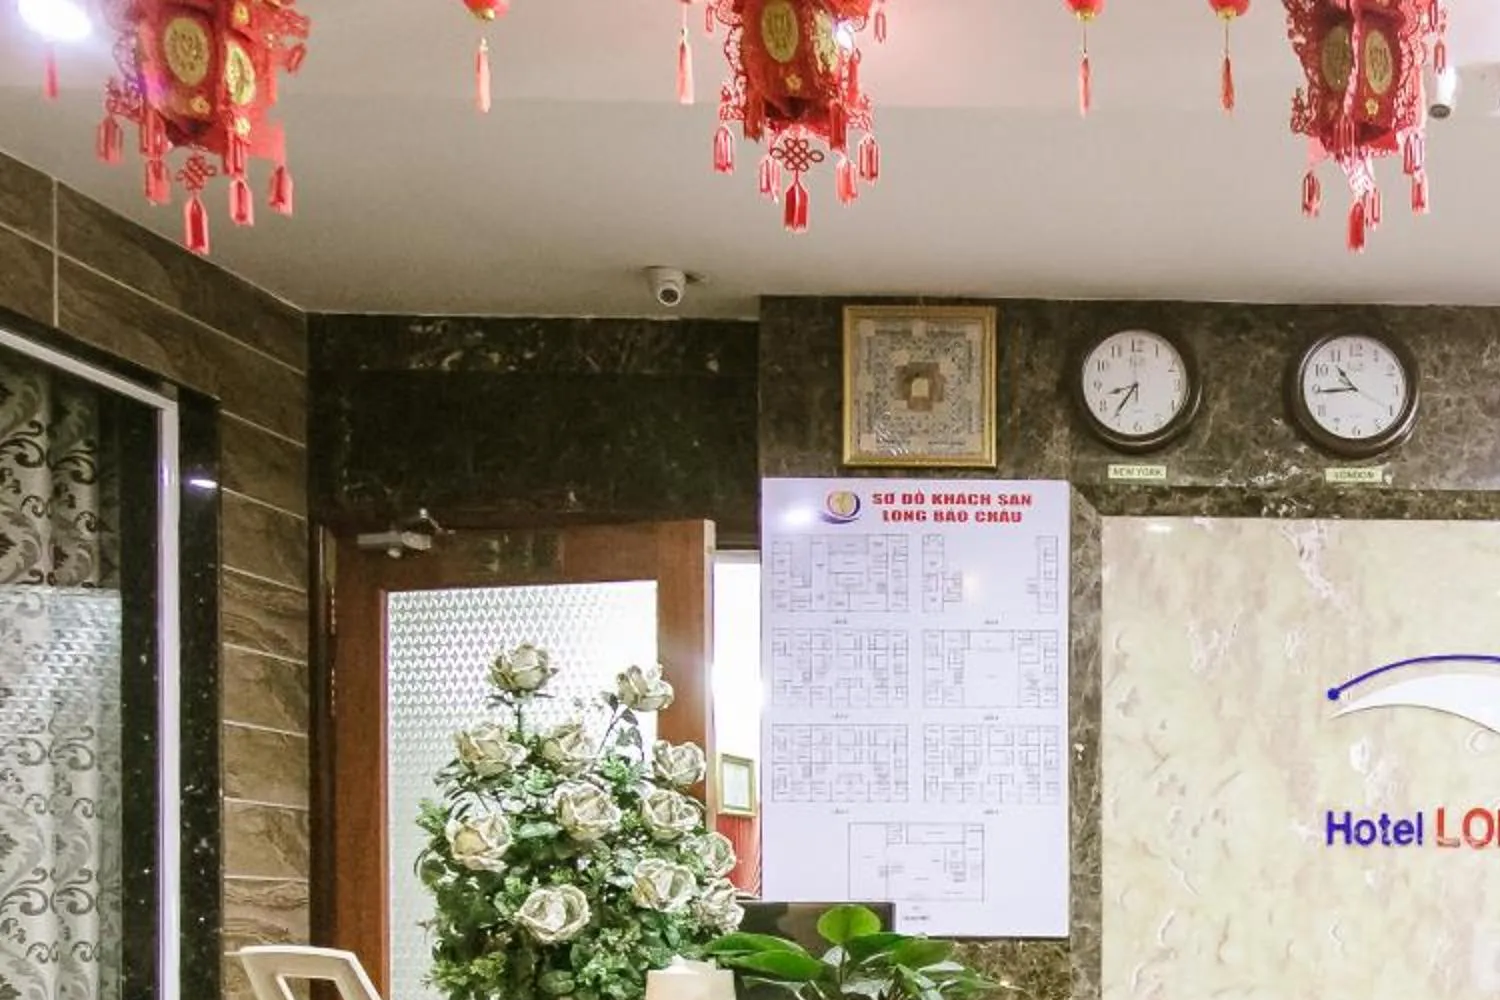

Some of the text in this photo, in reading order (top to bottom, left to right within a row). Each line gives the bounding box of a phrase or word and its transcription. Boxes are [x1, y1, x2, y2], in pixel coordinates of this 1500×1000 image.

[1113, 467, 1134, 477] NEW
[882, 510, 927, 522] LONG
[1326, 810, 1423, 846] Hotel
